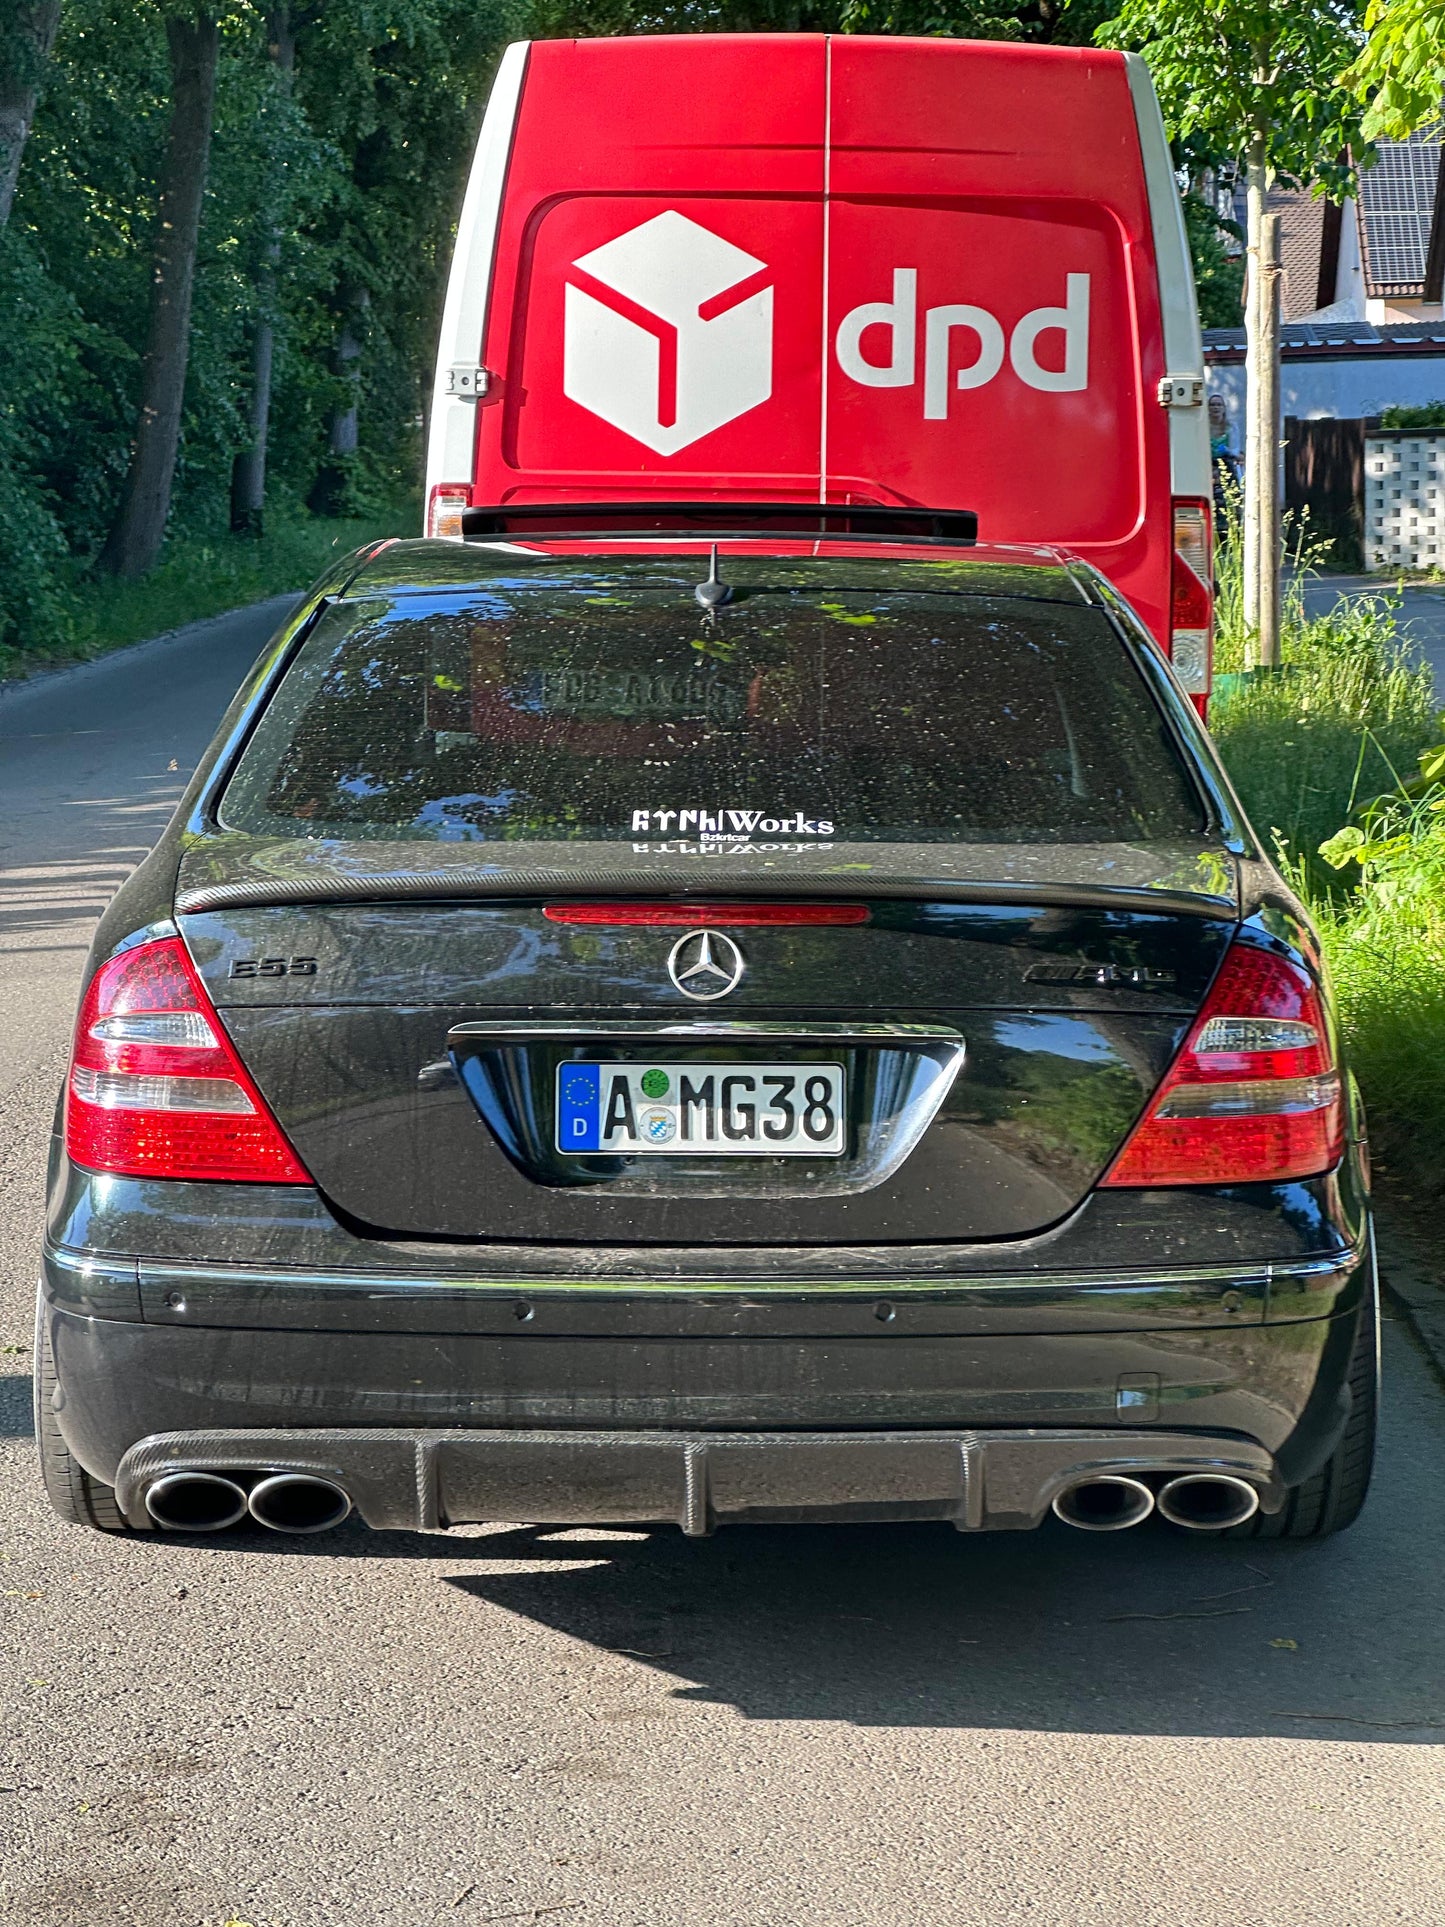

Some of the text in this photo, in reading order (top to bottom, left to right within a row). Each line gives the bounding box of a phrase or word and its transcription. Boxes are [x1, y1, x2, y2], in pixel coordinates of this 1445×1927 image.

[836, 268, 1090, 419] dpd
[725, 810, 834, 834] Works
[228, 957, 318, 979] E55
[680, 1075, 835, 1141] MG38
[573, 1118, 588, 1136] D
